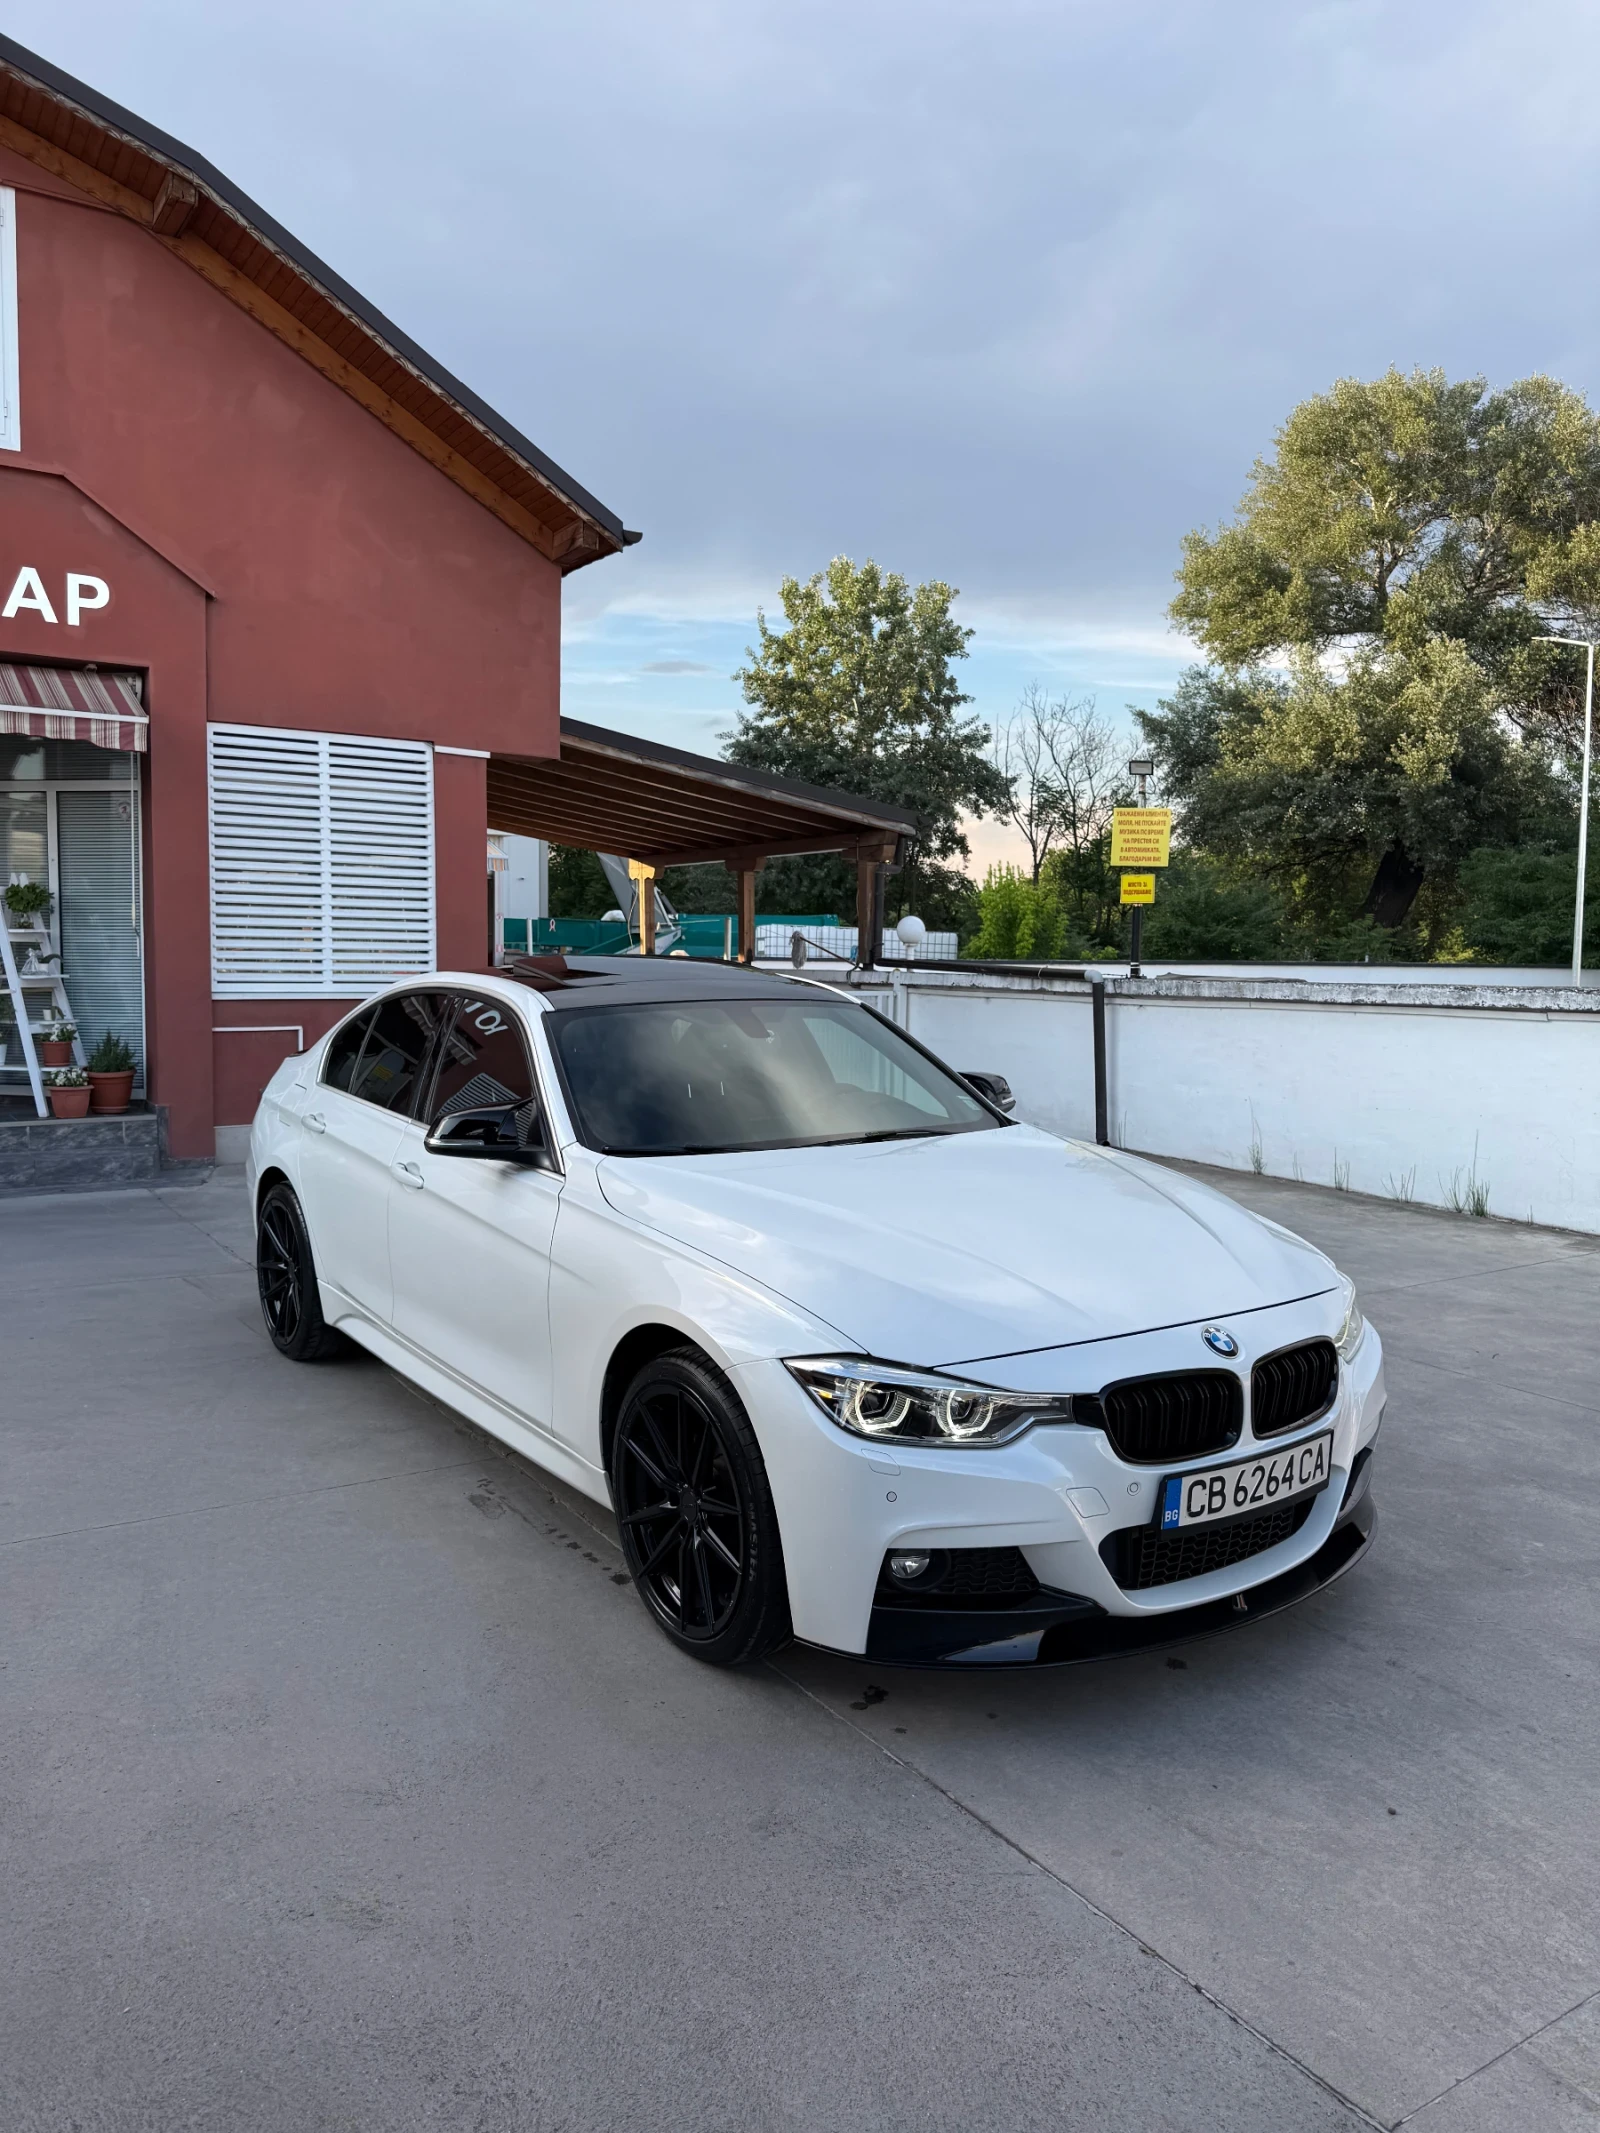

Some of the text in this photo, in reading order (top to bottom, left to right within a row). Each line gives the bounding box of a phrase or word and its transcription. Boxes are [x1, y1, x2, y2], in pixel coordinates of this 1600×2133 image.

[1164, 1442, 1324, 1522] BG CB 6264 CA
